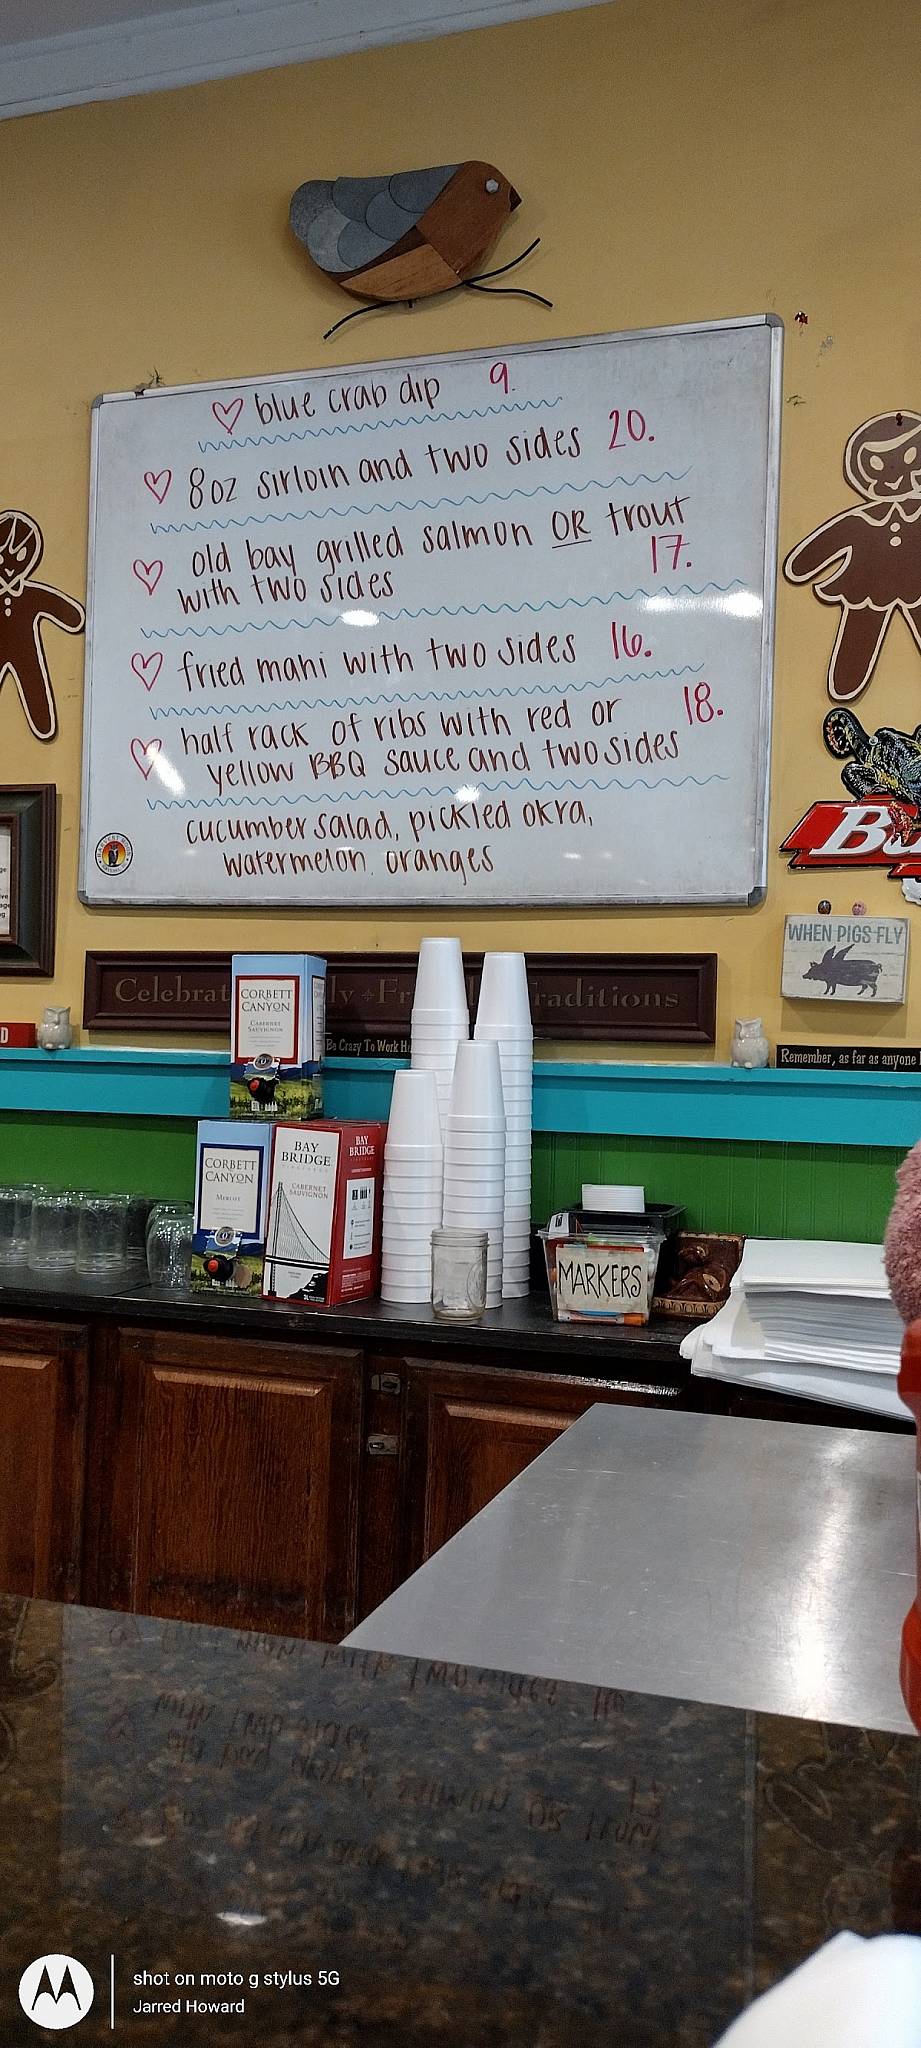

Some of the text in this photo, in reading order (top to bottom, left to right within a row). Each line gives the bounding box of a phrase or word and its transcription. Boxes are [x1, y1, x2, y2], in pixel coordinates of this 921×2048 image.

[255, 391, 315, 425] blue
[328, 380, 387, 411] crab
[399, 372, 440, 410] dip
[257, 463, 350, 499] sirloin
[358, 449, 412, 484] and
[424, 444, 489, 475] two
[506, 426, 581, 466] sides
[608, 409, 655, 450] 20.
[192, 495, 691, 577] old bay grilled salmon OR trout
[650, 534, 692, 574] 17.
[177, 570, 394, 614] with two sides
[177, 621, 652, 692] fried mahi with two sides 16.
[180, 681, 724, 756] half rack of ribs with red or 18.
[207, 729, 679, 796] yellow BBQ sauce and two sides
[186, 799, 593, 845] cucumber salad, pickled okra,
[386, 845, 494, 885] oranges
[788, 924, 903, 945] WHEN PIGS FLY
[115, 974, 232, 1003] Celebrat
[241, 989, 293, 1000] CORBETT
[242, 1002, 290, 1012] CANYON
[338, 1041, 361, 1056] Crazy
[364, 1040, 375, 1052] To
[377, 1040, 399, 1053] Work
[781, 1048, 836, 1067] Remember,
[839, 1054, 849, 1064] as
[852, 1049, 866, 1065] far
[868, 1056, 879, 1065] as
[882, 1054, 917, 1070] anyone
[294, 1141, 319, 1153] BAY
[349, 1146, 375, 1157] BRIDGE
[355, 1135, 369, 1146] BAY
[205, 1157, 257, 1171] CORBETT
[282, 1151, 331, 1167] BRIDGE
[205, 1171, 254, 1184] CANYON
[558, 1260, 643, 1299] MARKERS
